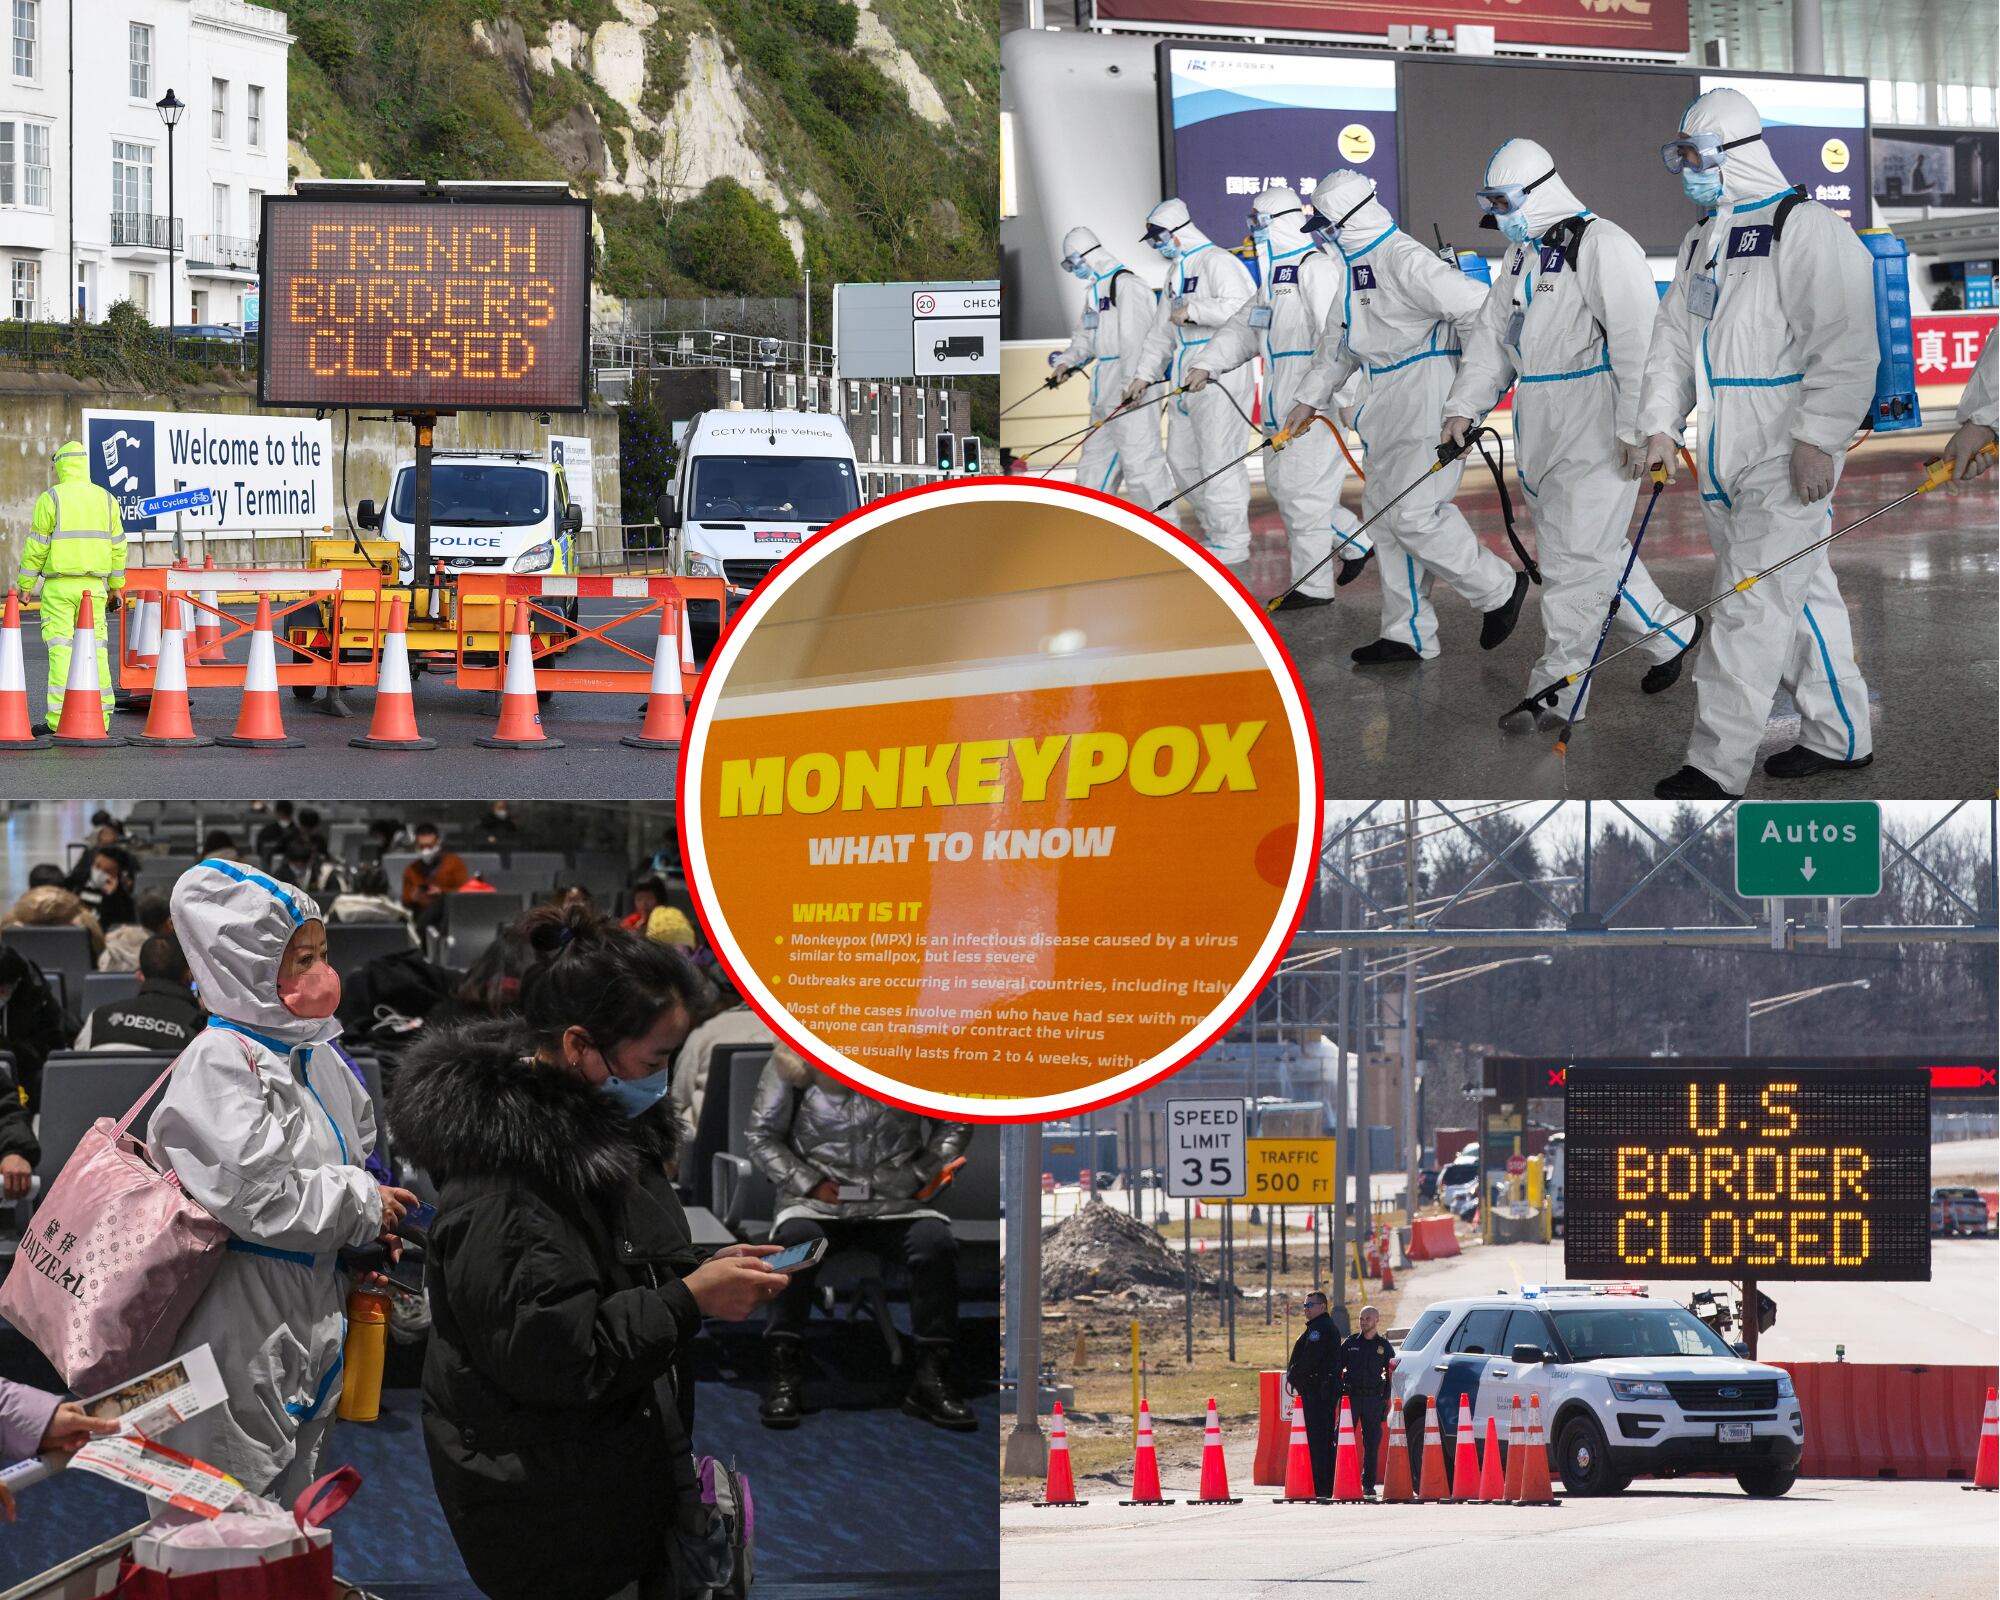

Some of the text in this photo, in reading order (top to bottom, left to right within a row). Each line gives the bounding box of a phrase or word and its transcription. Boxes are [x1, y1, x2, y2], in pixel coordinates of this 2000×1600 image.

[310, 225, 536, 273] FRENCH
[1737, 229, 1760, 253] 防
[1279, 268, 1293, 281] 防
[290, 278, 555, 327] BORDERS
[919, 300, 933, 309] 20
[309, 330, 534, 378] CLOSED
[711, 427, 833, 438] CCTV Mobile Vehicle
[169, 427, 321, 466] Welcome to the
[148, 497, 188, 511] All Cycles
[234, 479, 316, 516] Terminal
[430, 537, 501, 547] POLICE
[720, 720, 1268, 818] MONKEYPOX
[1760, 819, 1857, 843] Autos
[808, 826, 1116, 865] WHAT TO KNOW
[792, 902, 923, 923] WHAT IS IT
[791, 933, 1239, 949] Monkeypox (MPX) is an infectious disease caused by a virus
[789, 950, 1035, 965] similar to smallpox, but less severe
[788, 973, 1231, 996] Outbreaks are occurring in several countries, including Italy
[786, 1002, 819, 1015] Most
[822, 1002, 838, 1015] of
[839, 1003, 861, 1016] the
[864, 1006, 902, 1017] cases
[905, 1005, 957, 1018] involve
[960, 1008, 992, 1020] men
[996, 1008, 1029, 1020] who
[1032, 1008, 1070, 1021] have
[1073, 1009, 1103, 1023] had
[1107, 1012, 1135, 1024] sex
[1138, 1011, 1176, 1025] with
[810, 1021, 857, 1035] anyone
[860, 1023, 884, 1033] can
[887, 1021, 949, 1035] transmit
[952, 1025, 967, 1036] or
[970, 1024, 1032, 1037] contract
[1036, 1025, 1062, 1038] the
[1066, 1026, 1105, 1040] virus
[863, 1045, 912, 1061] usually
[915, 1046, 950, 1059] lasts
[953, 1047, 988, 1061] from
[992, 1050, 1001, 1061] 2
[1006, 1051, 1021, 1063] to
[1024, 1051, 1034, 1063] 4
[1039, 1051, 1092, 1068] weeks,
[1098, 1053, 1134, 1068] with
[1174, 1110, 1238, 1126] SPEED
[1689, 1083, 1798, 1137] U.S
[1181, 1134, 1231, 1149] LIMIT
[1260, 1151, 1319, 1164] TRAFFIC
[1508, 1161, 1526, 1169] STOP
[1181, 1157, 1232, 1187] 35
[1256, 1173, 1329, 1192] 500 FT
[1618, 1147, 1869, 1201] BORDER
[1618, 1211, 1869, 1265] CLOSED
